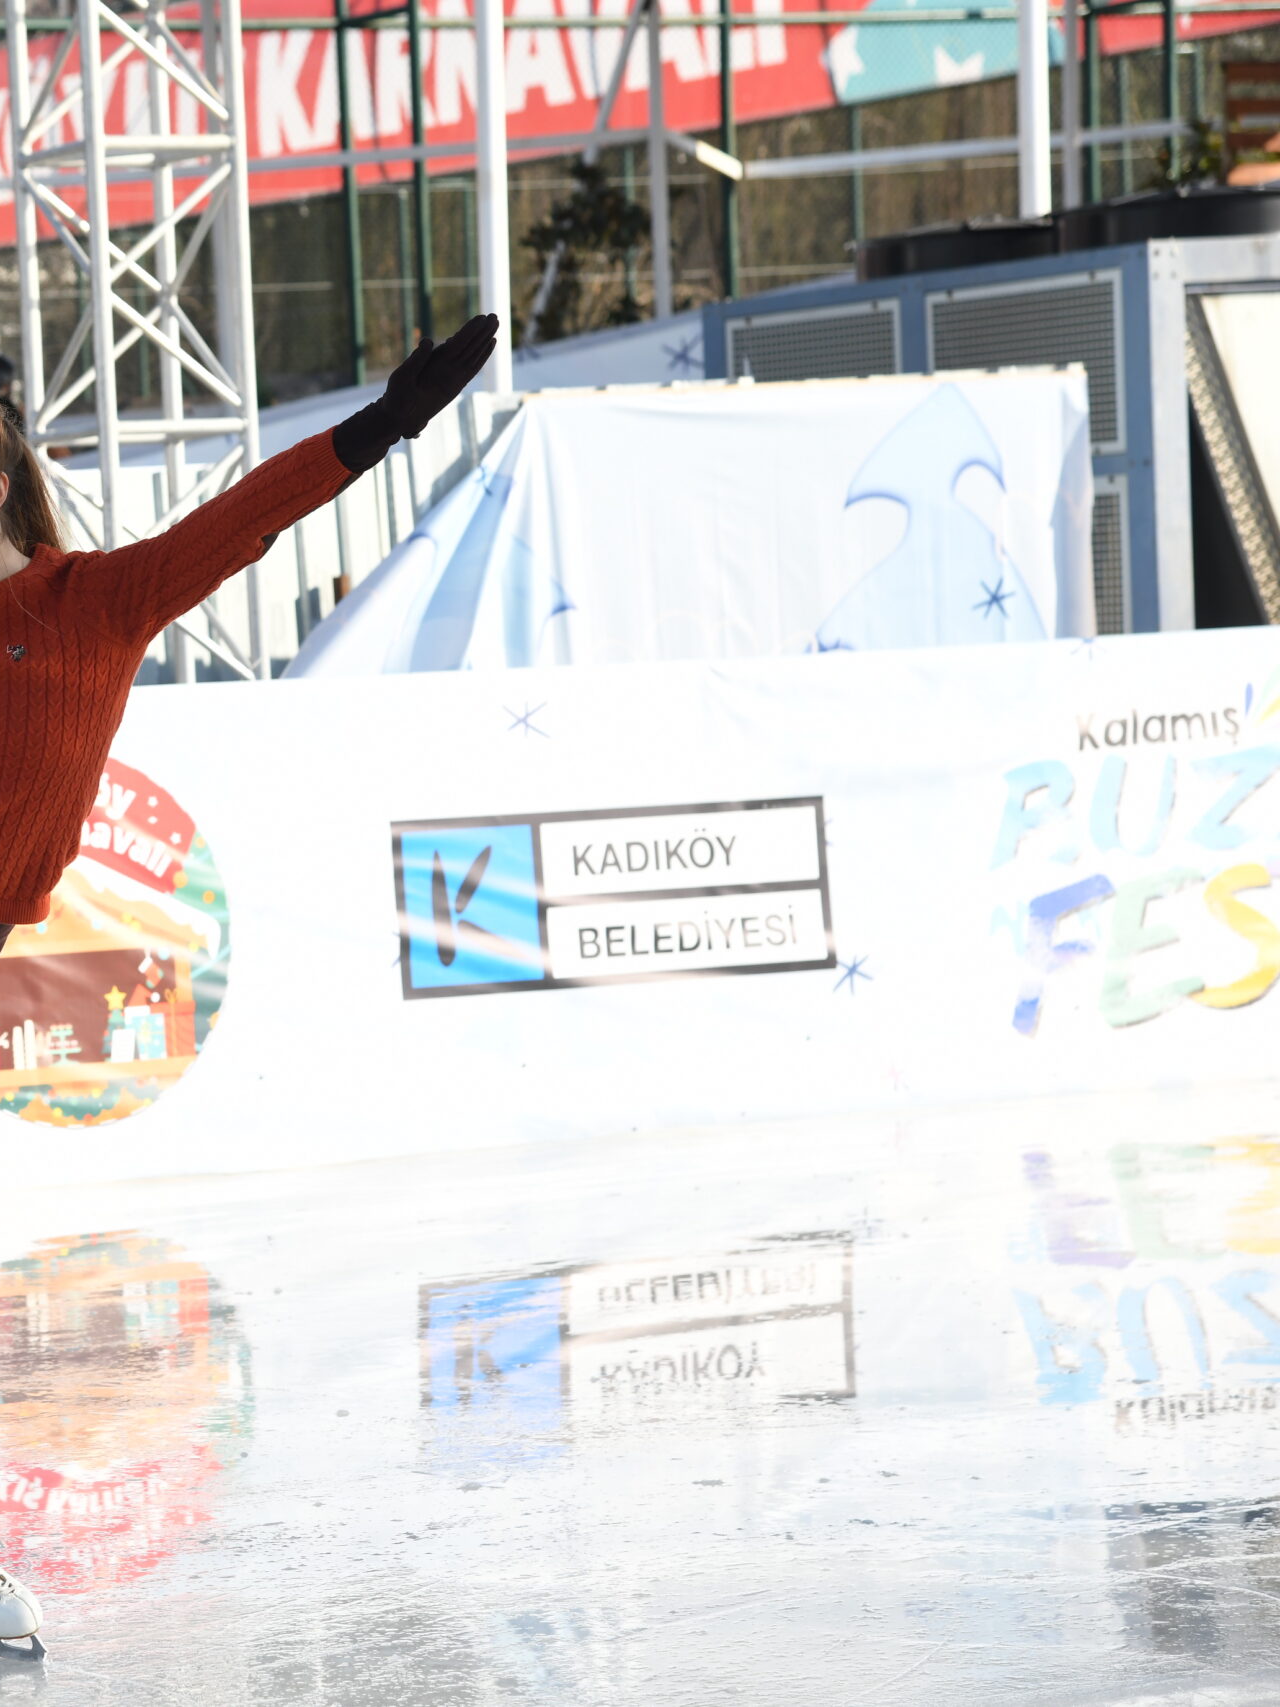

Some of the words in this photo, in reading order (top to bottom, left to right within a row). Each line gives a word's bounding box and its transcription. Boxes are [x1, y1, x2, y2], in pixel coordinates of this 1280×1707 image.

[572, 828, 737, 877] KADIKÖY
[577, 904, 798, 960] BELEDİYESİ
[1011, 860, 1280, 1037] FES
